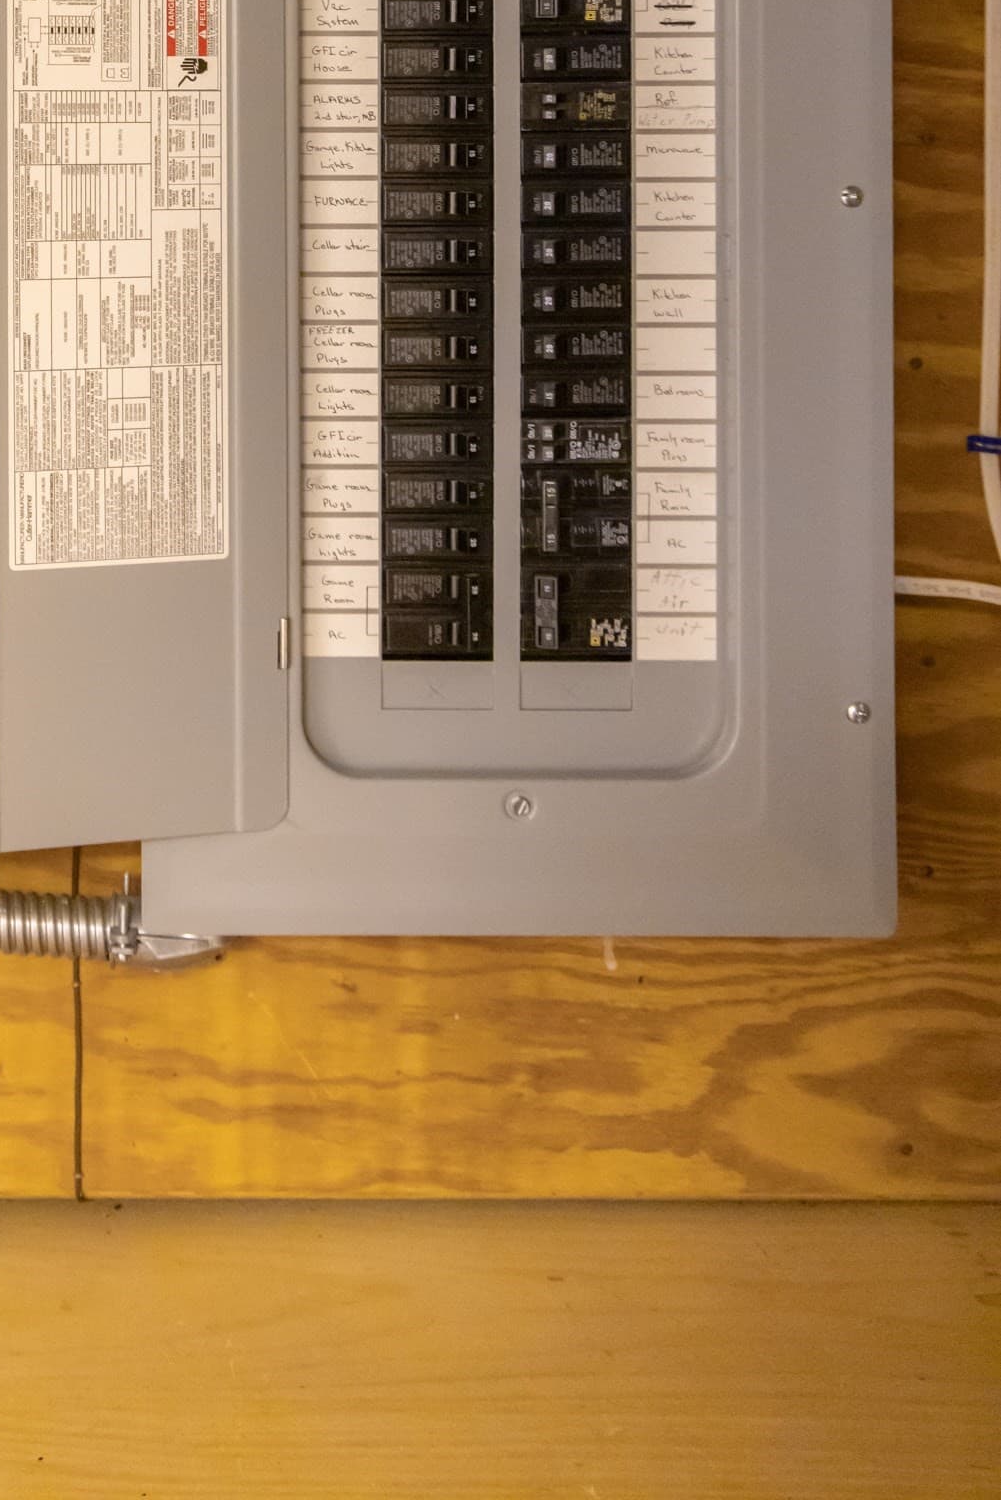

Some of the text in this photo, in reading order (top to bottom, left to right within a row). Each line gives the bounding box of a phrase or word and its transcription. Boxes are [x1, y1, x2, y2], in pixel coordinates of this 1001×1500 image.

[312, 45, 336, 56] GFI
[654, 46, 693, 60] Kitchen
[313, 94, 362, 104] ALARMS
[314, 195, 368, 207] FURNACE
[654, 190, 695, 202] Kitchen
[328, 629, 347, 640] AC
